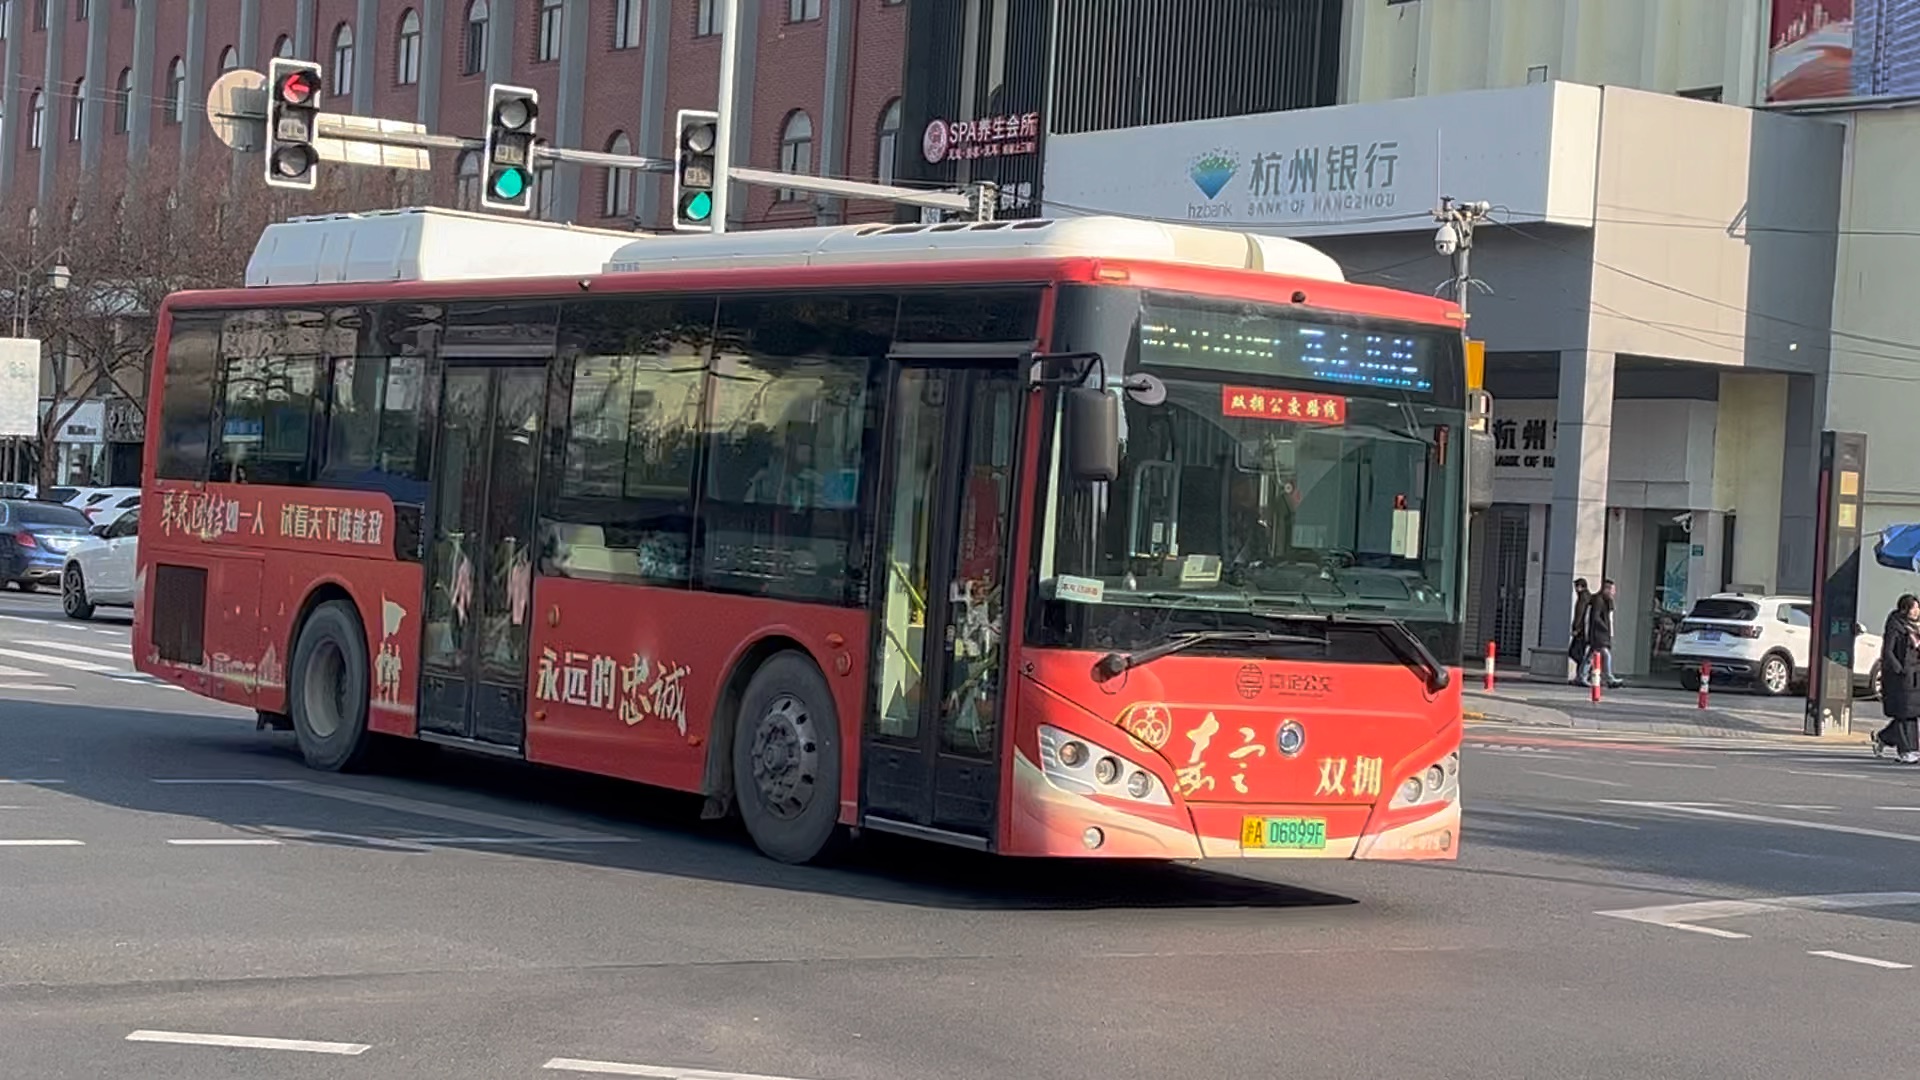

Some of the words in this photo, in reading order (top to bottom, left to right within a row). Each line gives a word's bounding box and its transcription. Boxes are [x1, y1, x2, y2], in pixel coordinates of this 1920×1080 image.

[1250, 142, 1398, 196] 杭州银行
[1187, 201, 1232, 218] hzbank
[1248, 201, 1282, 216] BANK
[1290, 199, 1305, 214] OF
[1313, 193, 1396, 212] HANGZHOU
[280, 503, 384, 544] 试看天下谁能敌
[536, 646, 692, 737] 永远的忠诚
[1315, 755, 1383, 796] 双拥
